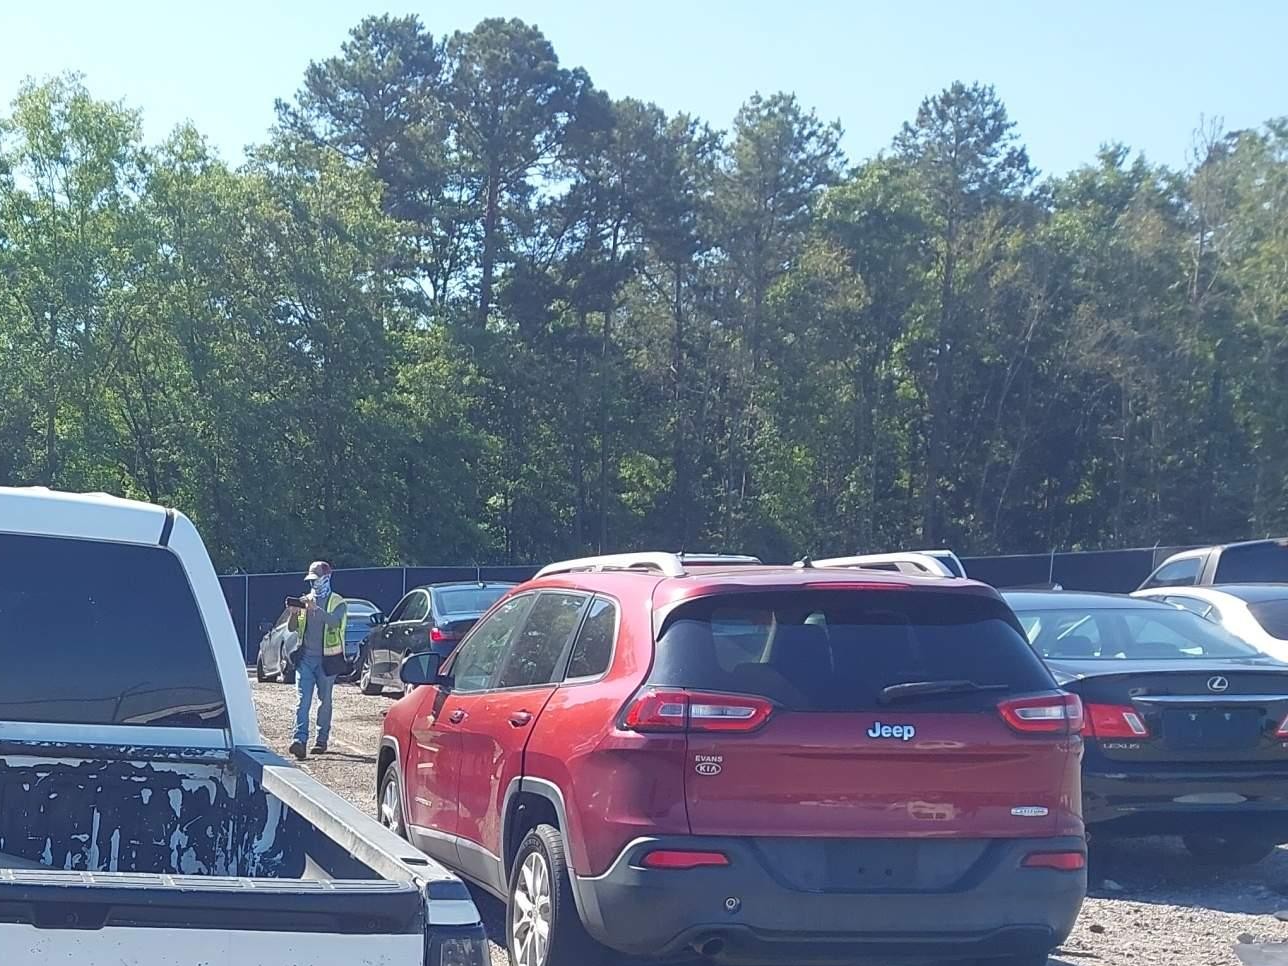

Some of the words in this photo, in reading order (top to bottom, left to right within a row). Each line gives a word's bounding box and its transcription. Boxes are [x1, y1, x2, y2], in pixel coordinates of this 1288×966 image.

[867, 721, 915, 741] Jeep
[695, 755, 723, 763] EVANS
[699, 765, 717, 773] KIA
